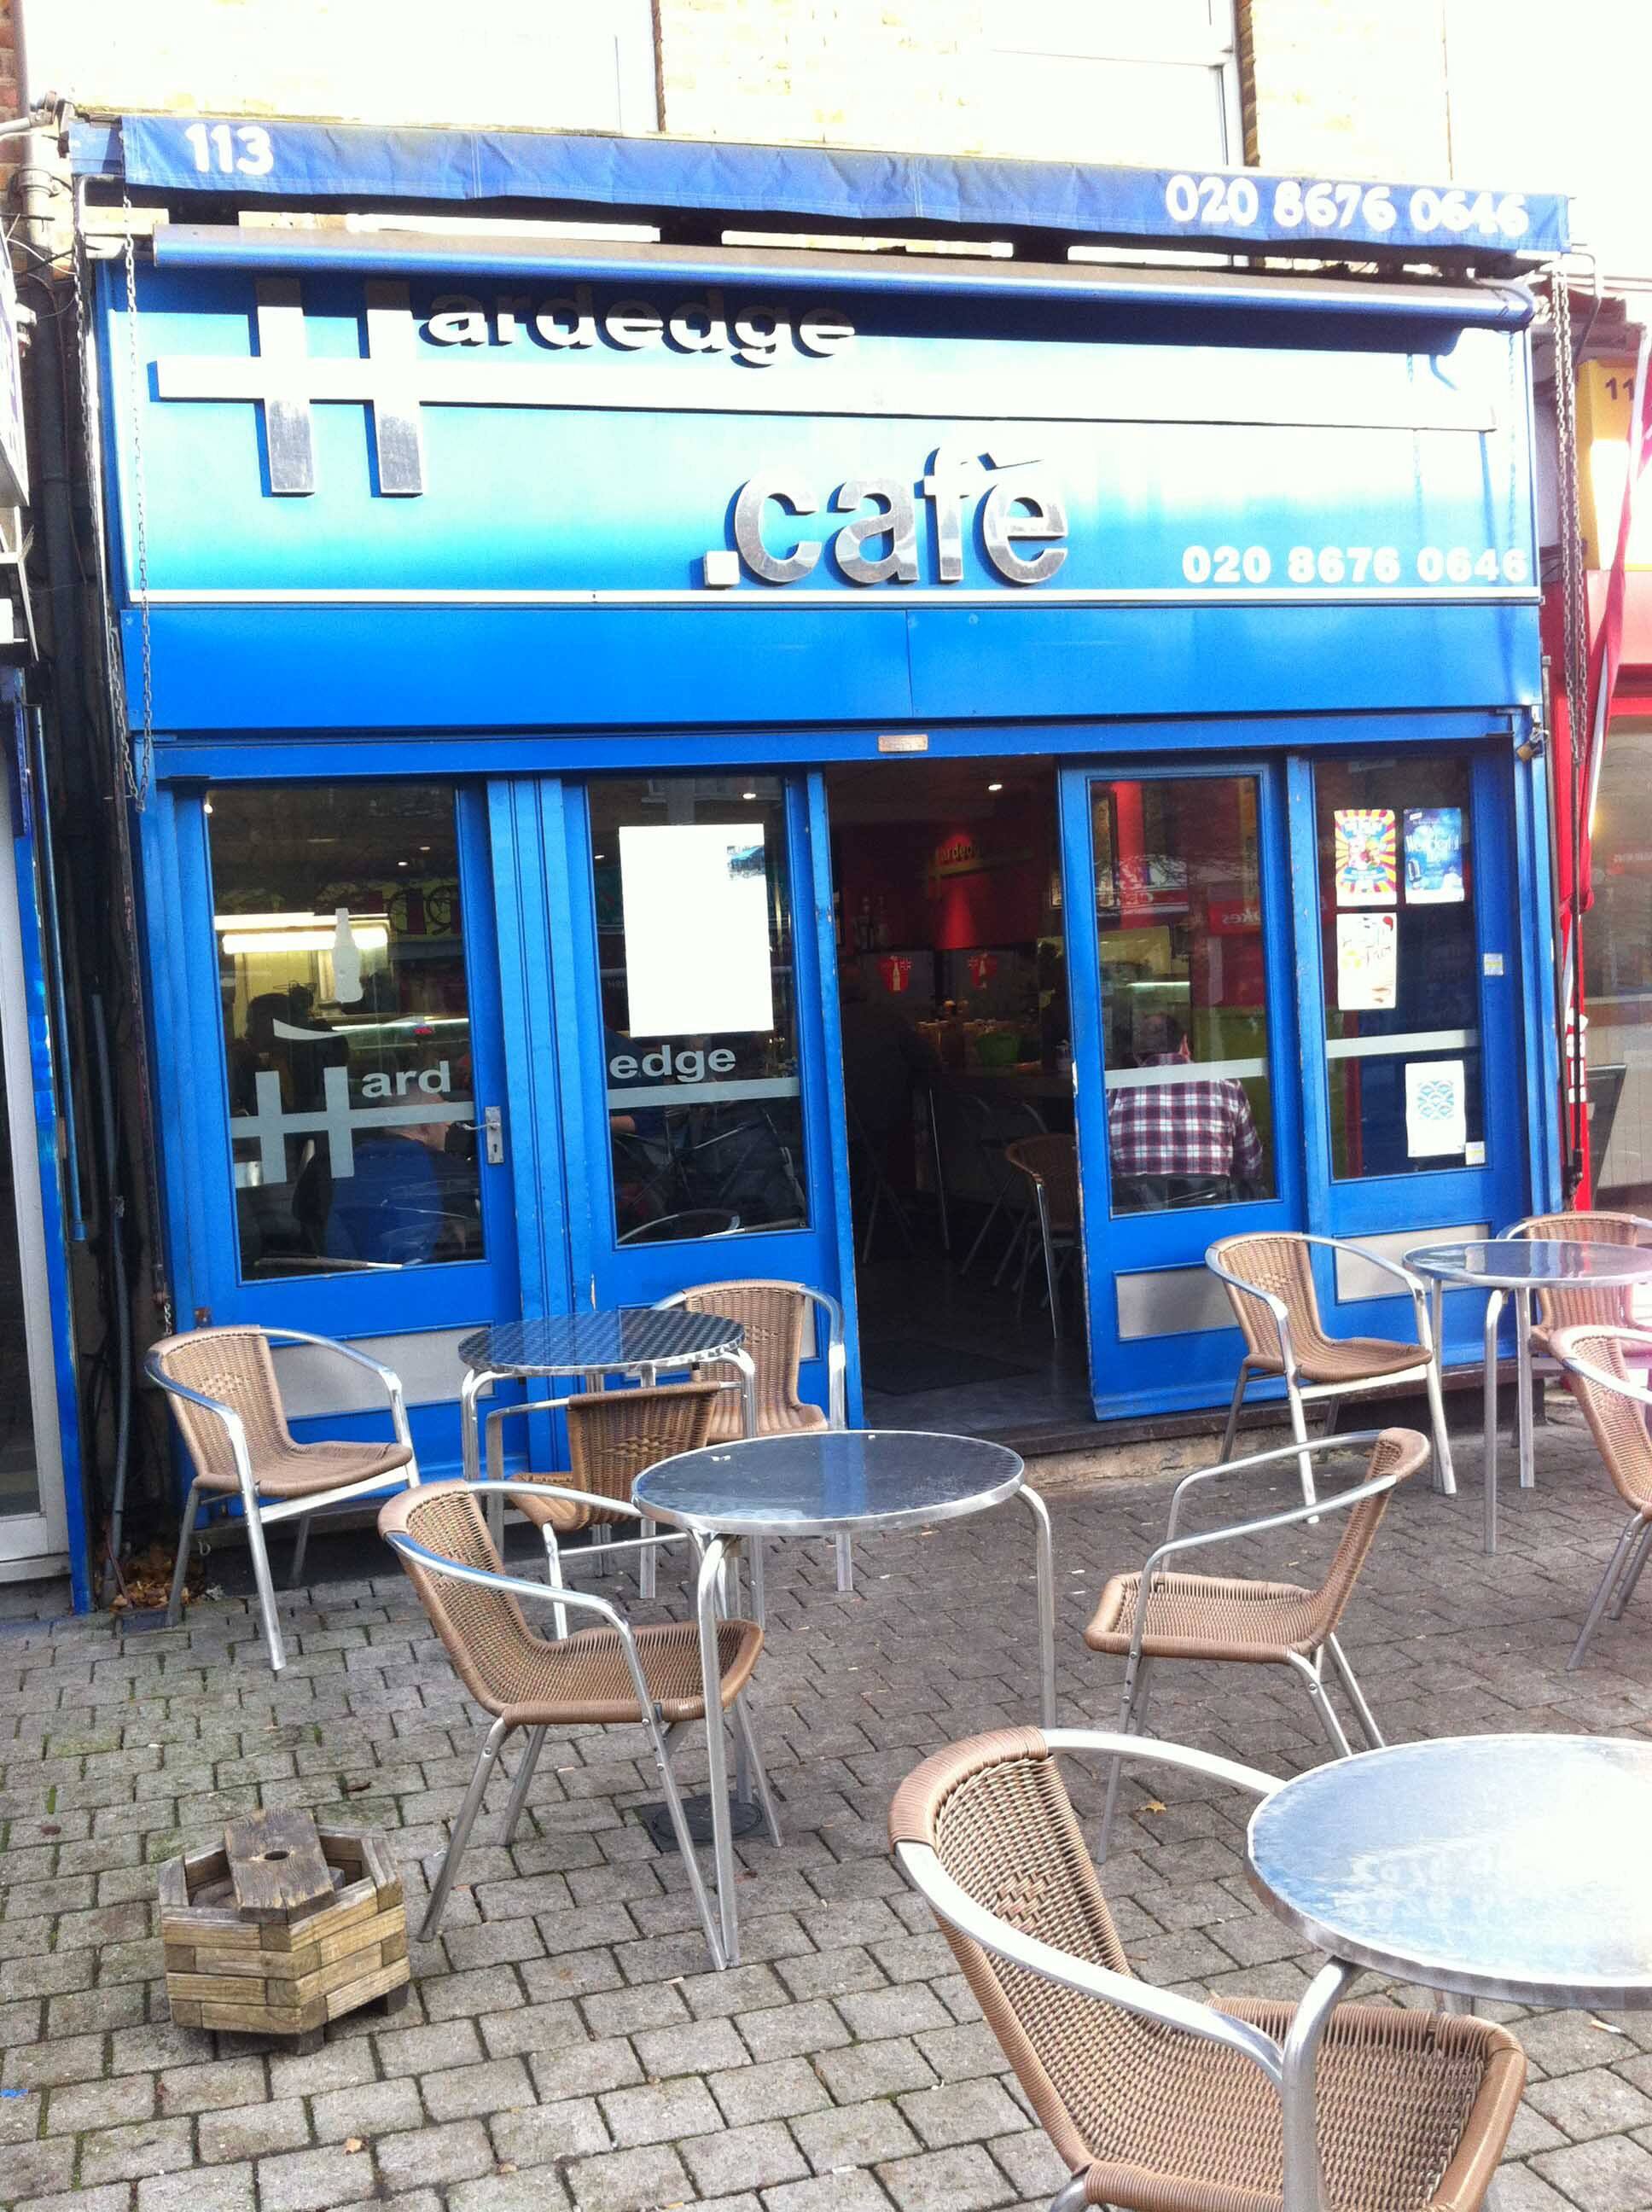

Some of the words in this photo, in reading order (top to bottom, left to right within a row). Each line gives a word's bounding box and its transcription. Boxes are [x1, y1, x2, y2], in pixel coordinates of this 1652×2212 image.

[184, 123, 274, 177] 113
[1166, 174, 1259, 226] 020
[1273, 181, 1397, 231] 8676
[1410, 189, 1530, 236] 0646
[1182, 545, 1271, 584] 020
[1288, 546, 1401, 584] 8676
[1416, 547, 1528, 584] 0646
[609, 1044, 737, 1083] edge
